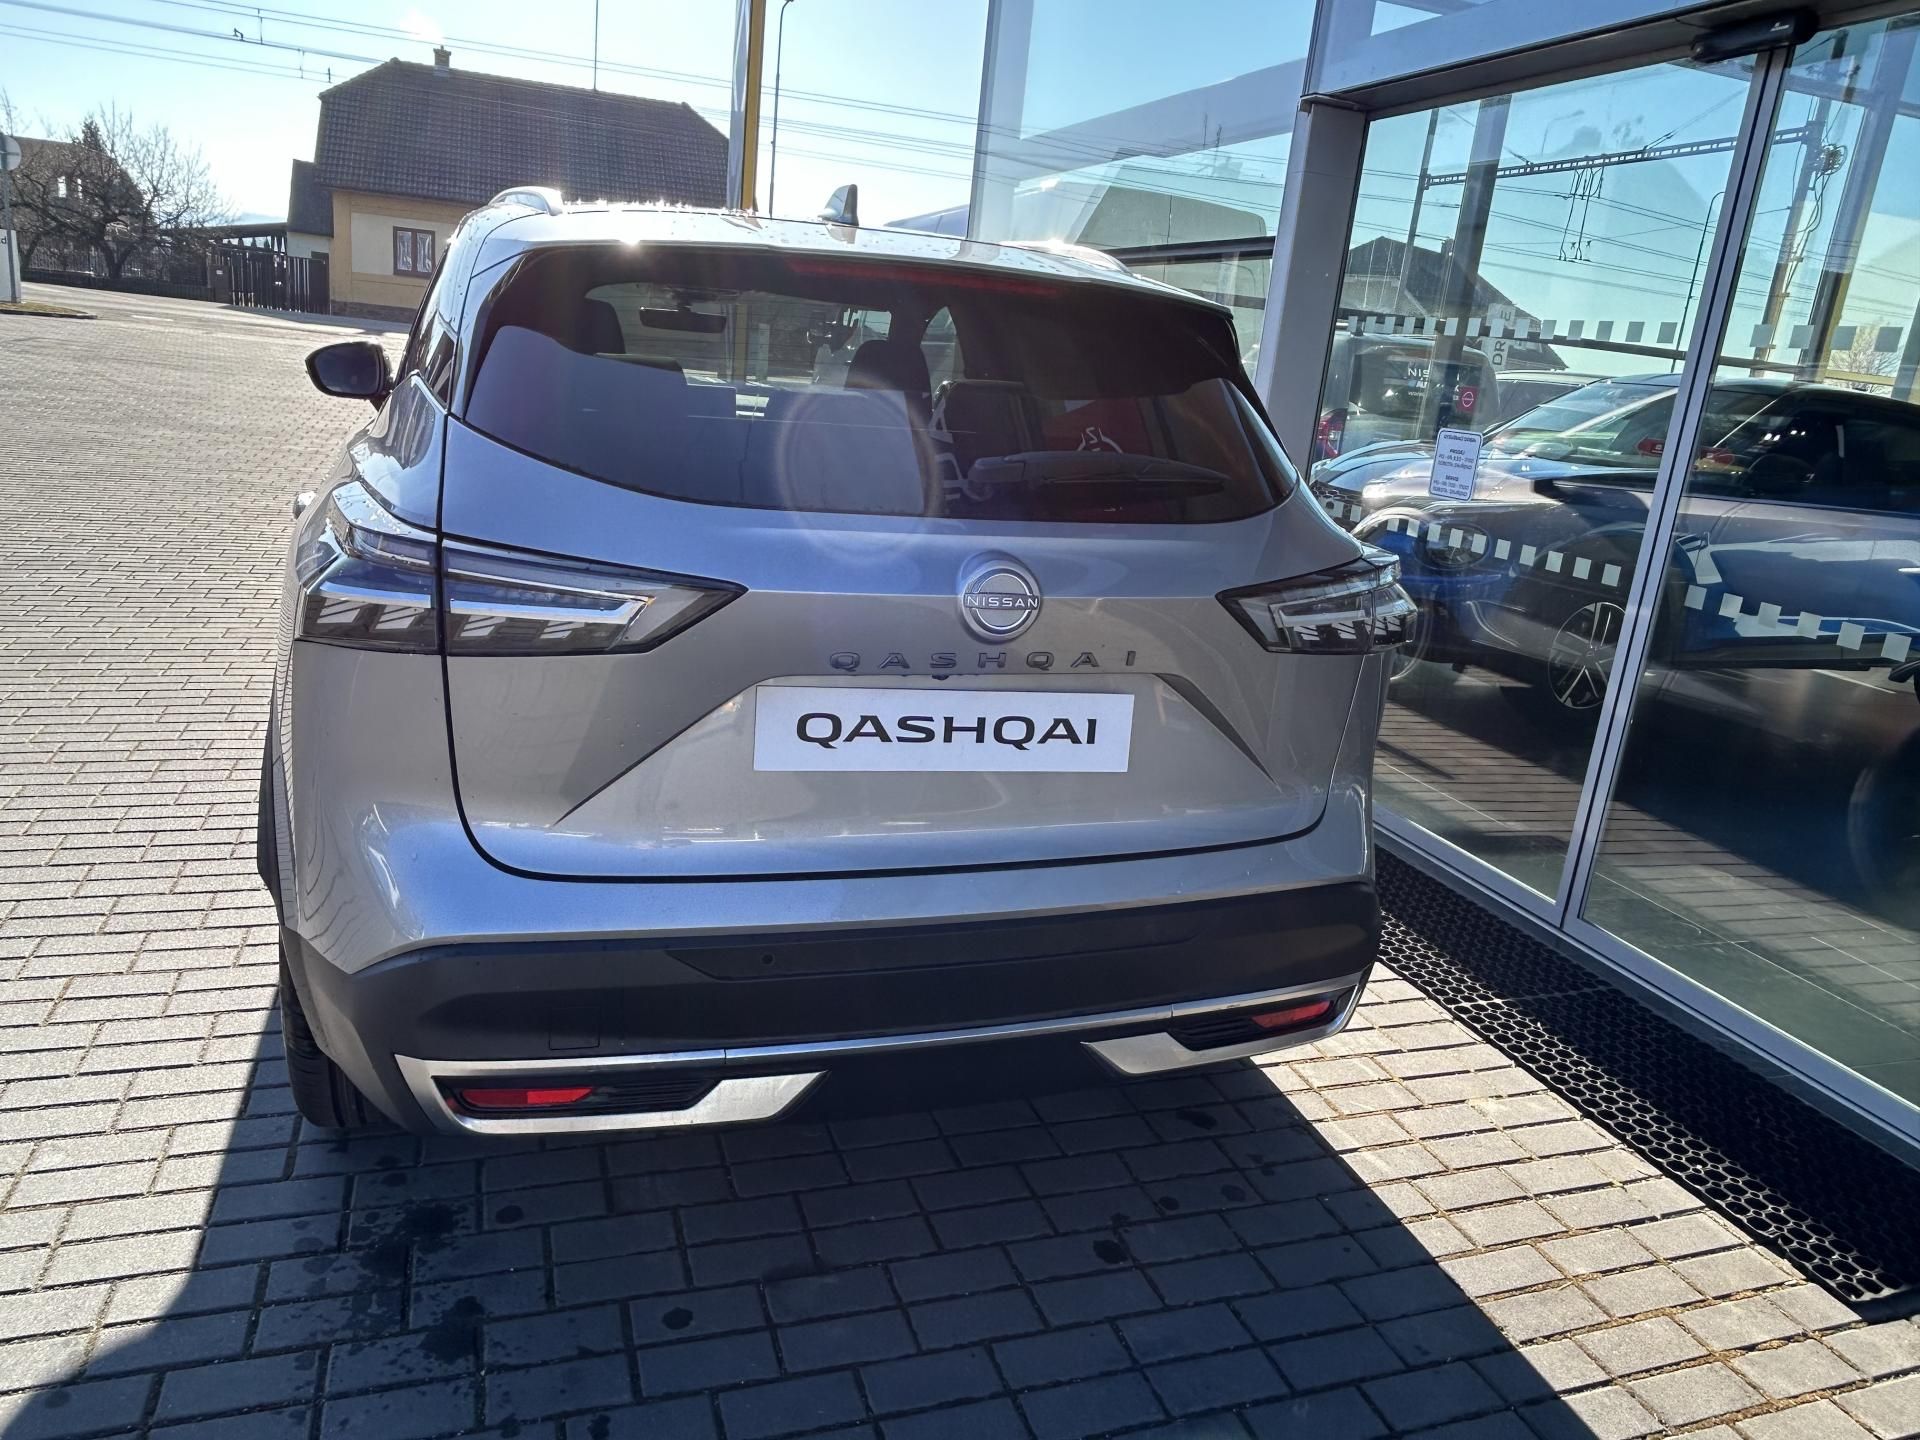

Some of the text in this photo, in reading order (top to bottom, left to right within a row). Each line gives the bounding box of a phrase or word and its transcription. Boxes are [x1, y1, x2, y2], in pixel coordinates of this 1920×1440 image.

[967, 594, 1039, 609] NISSAN
[829, 650, 1137, 672] QASHQAI
[796, 712, 1097, 750] QASHQAI
